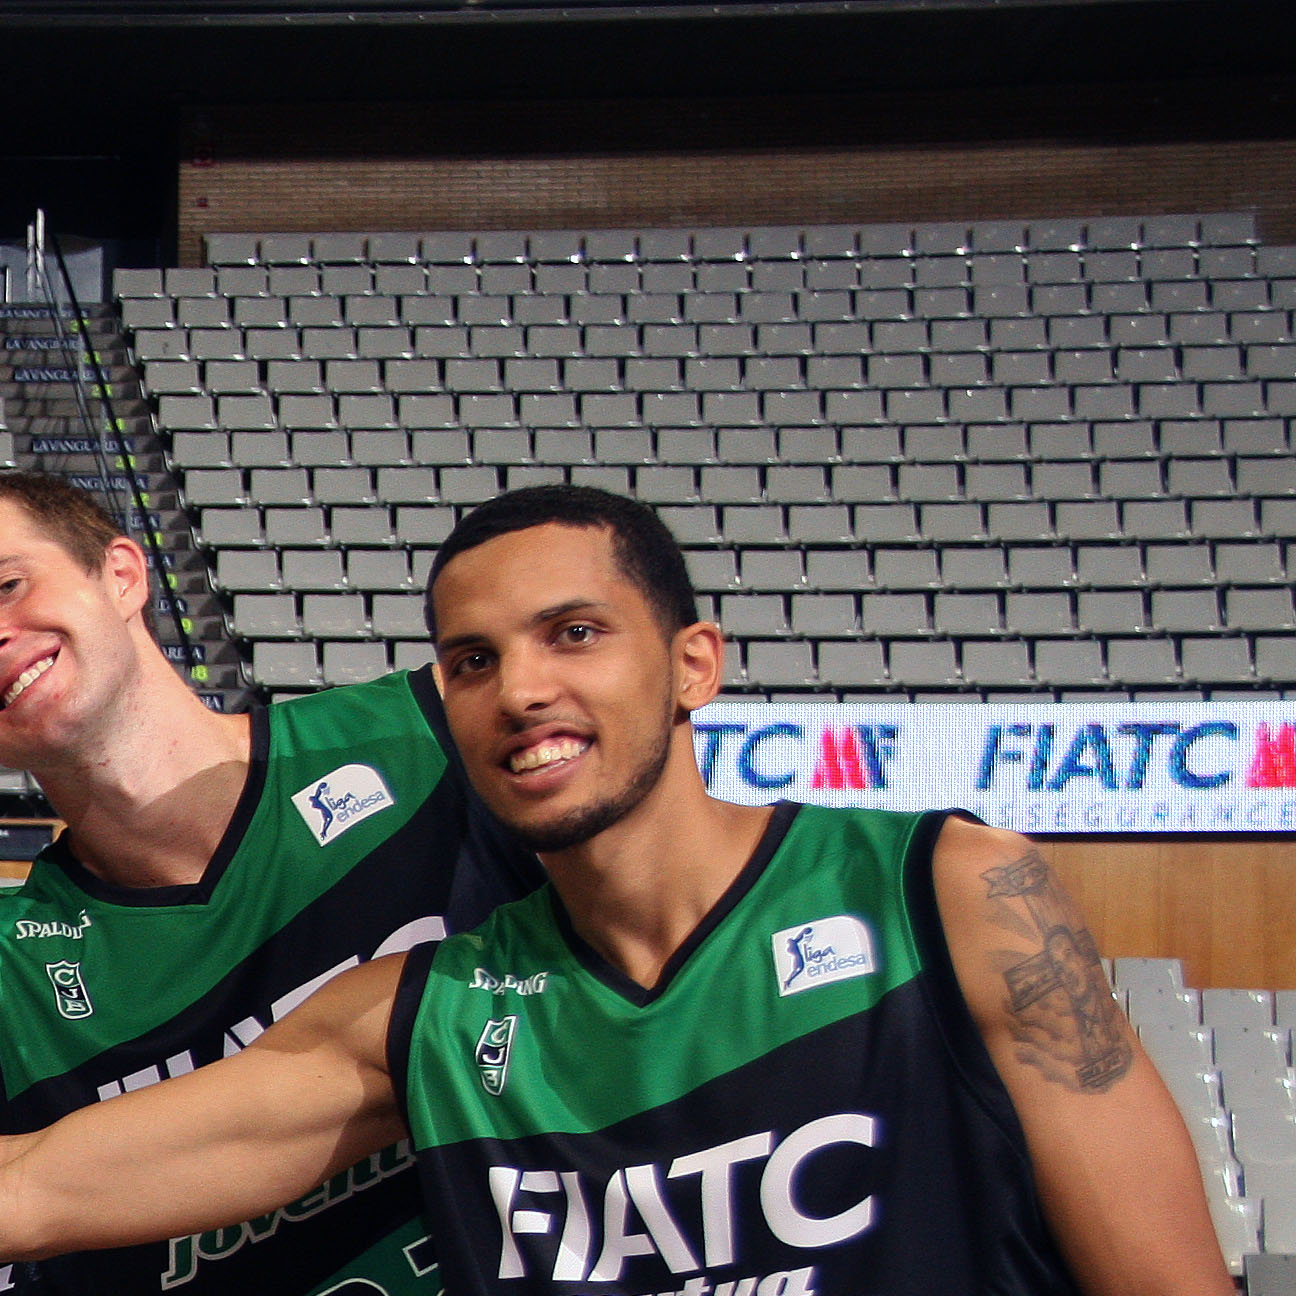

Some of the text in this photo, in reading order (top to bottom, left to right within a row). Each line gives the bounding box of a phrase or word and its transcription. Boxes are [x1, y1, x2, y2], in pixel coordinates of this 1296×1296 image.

[975, 720, 1239, 791] FIATC
[324, 791, 356, 812] liga
[336, 790, 386, 823] endesa
[803, 942, 837, 964] liga
[806, 953, 867, 978] endesa
[487, 1111, 877, 1284] FIATC
